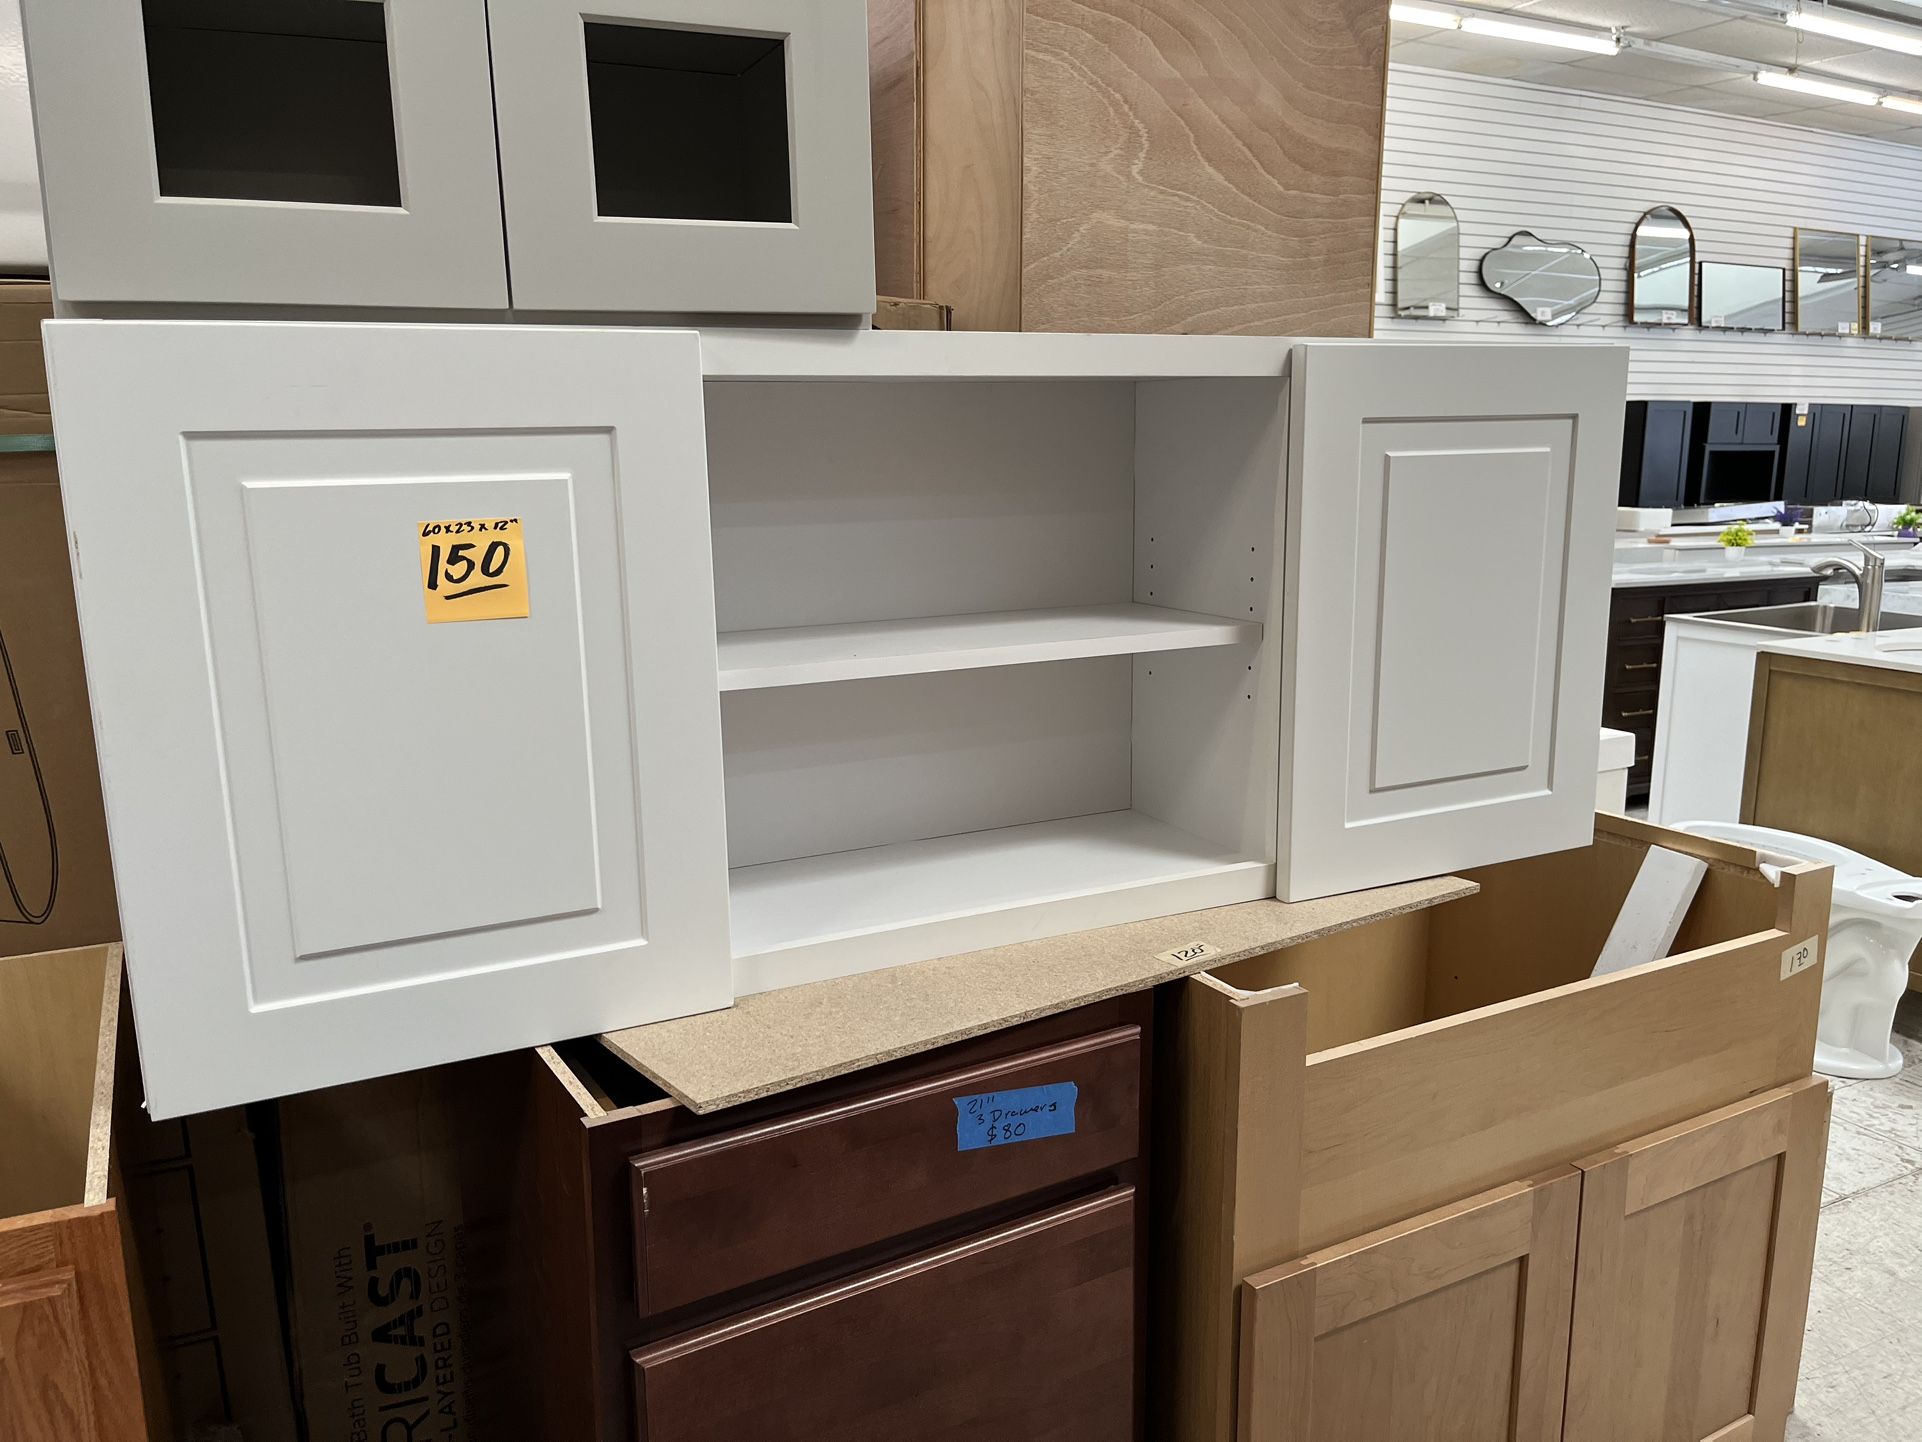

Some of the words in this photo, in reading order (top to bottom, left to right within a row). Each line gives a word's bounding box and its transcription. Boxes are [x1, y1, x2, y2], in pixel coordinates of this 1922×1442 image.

[427, 540, 511, 591] 150
[976, 1113, 985, 1126] 3
[989, 1101, 1057, 1123] Drawers
[986, 1122, 1026, 1145] $80
[333, 1246, 354, 1296] With
[424, 1219, 450, 1313] DESIGN
[337, 1299, 359, 1346] Built
[342, 1351, 363, 1394] Tub
[346, 1397, 368, 1442] Bath
